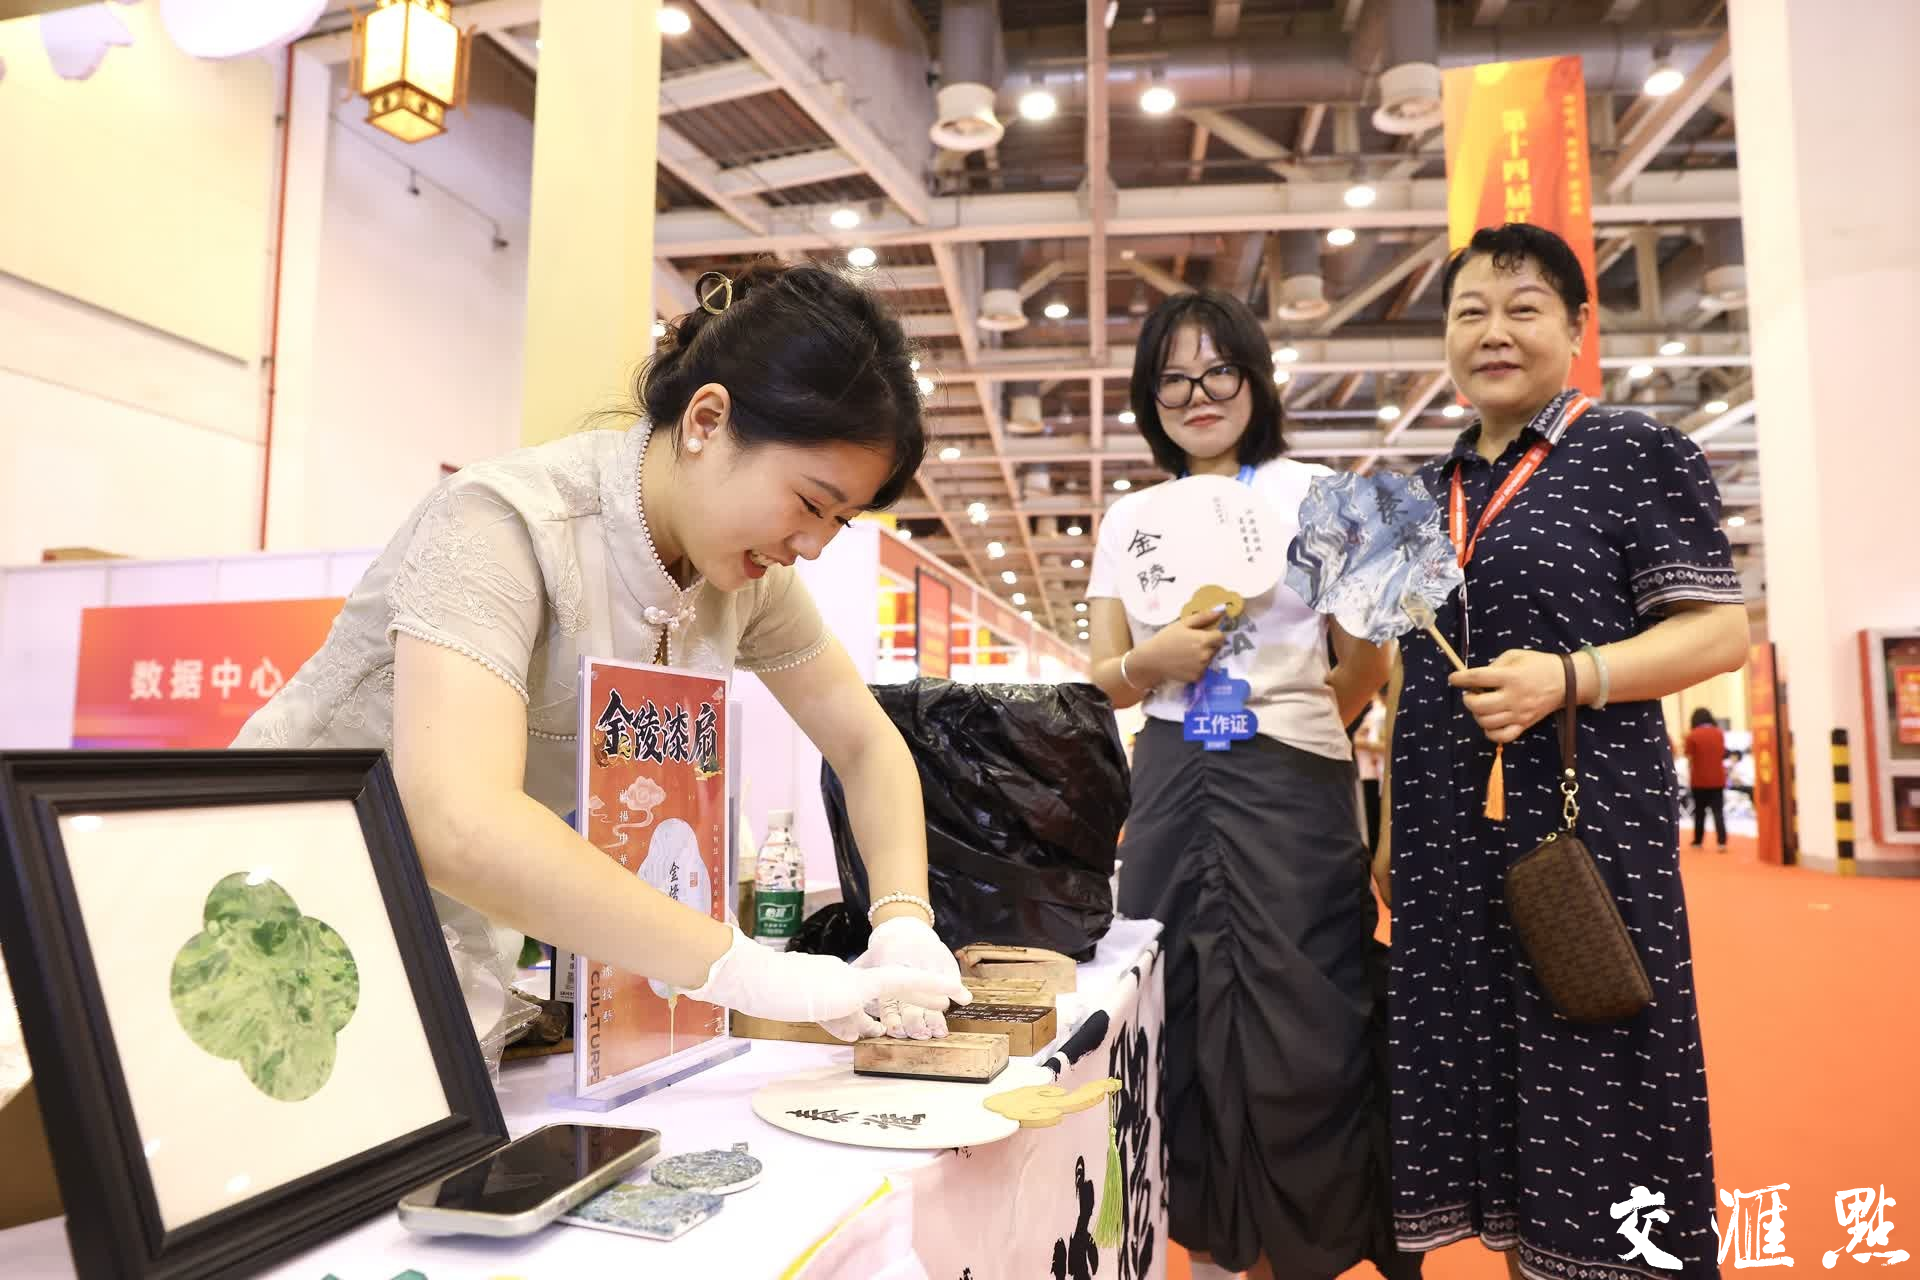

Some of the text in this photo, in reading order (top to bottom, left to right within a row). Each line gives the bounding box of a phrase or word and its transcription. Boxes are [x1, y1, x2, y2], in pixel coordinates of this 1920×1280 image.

[1127, 529, 1176, 593] 金陵
[130, 656, 283, 700] 数据中心
[596, 689, 718, 773] 金陵漆扇
[1193, 714, 1249, 735] 工作证
